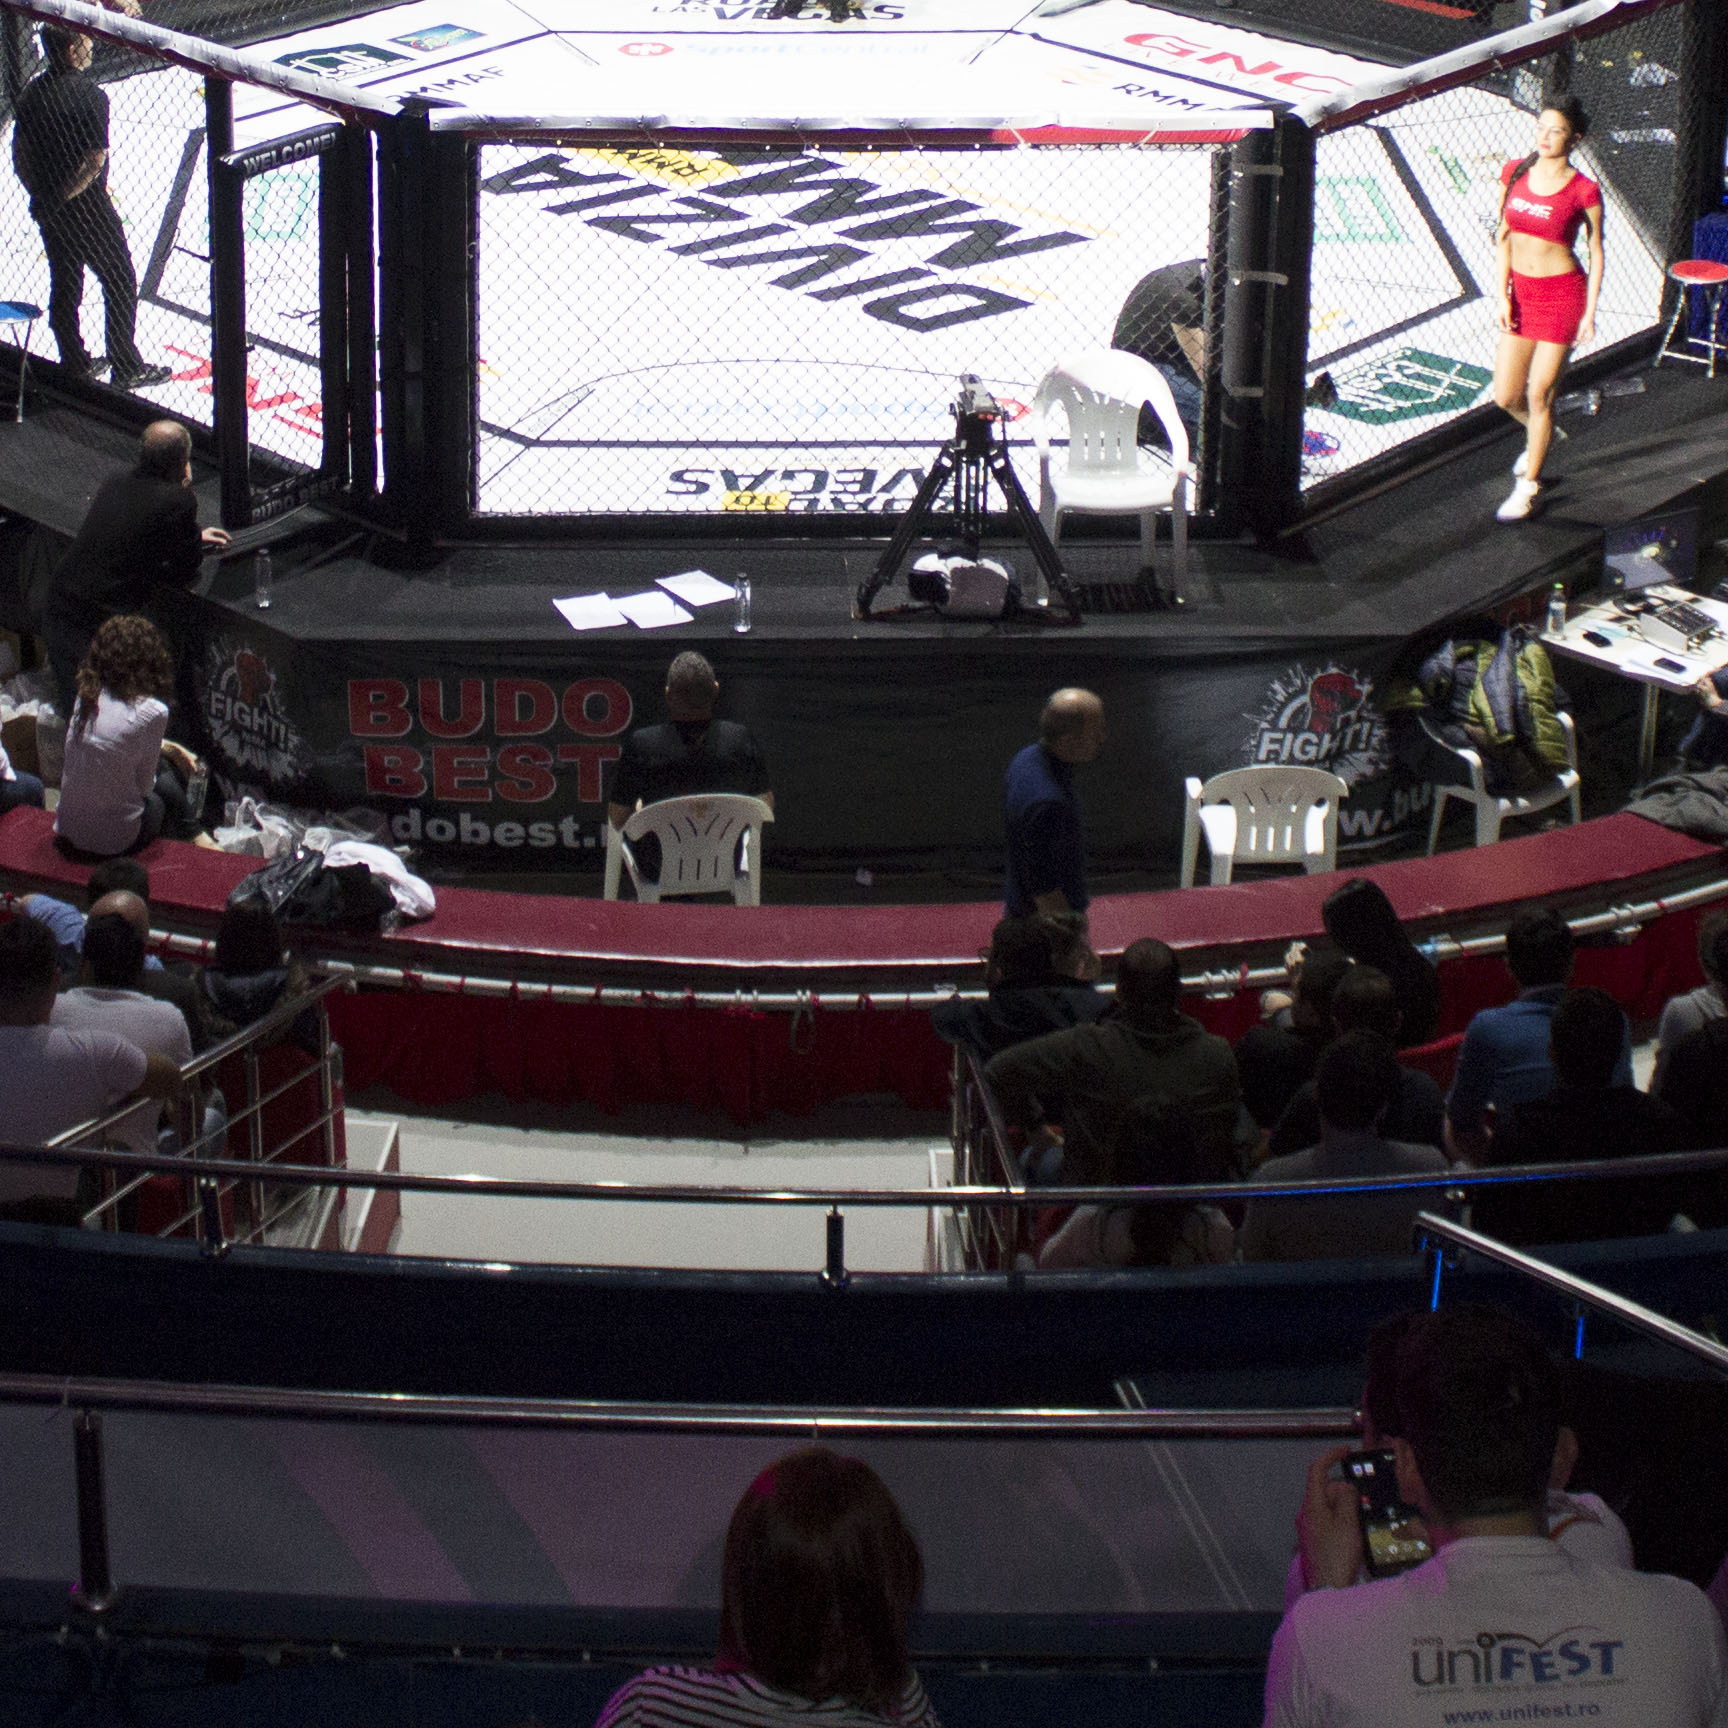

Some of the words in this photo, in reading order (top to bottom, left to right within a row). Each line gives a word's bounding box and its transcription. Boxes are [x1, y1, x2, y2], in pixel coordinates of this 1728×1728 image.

[1123, 32, 1354, 95] GNC
[1112, 82, 1224, 111] RMM
[242, 132, 337, 174] WELCOME!
[1511, 197, 1554, 217] GNC
[478, 155, 1033, 335] DIVIZIA
[665, 467, 928, 496] VEGAS
[346, 677, 635, 739] BUDO
[1256, 720, 1372, 762] FIGHT!
[361, 742, 624, 805] BEST
[1443, 1702, 1601, 1726] www.unifest.ro
